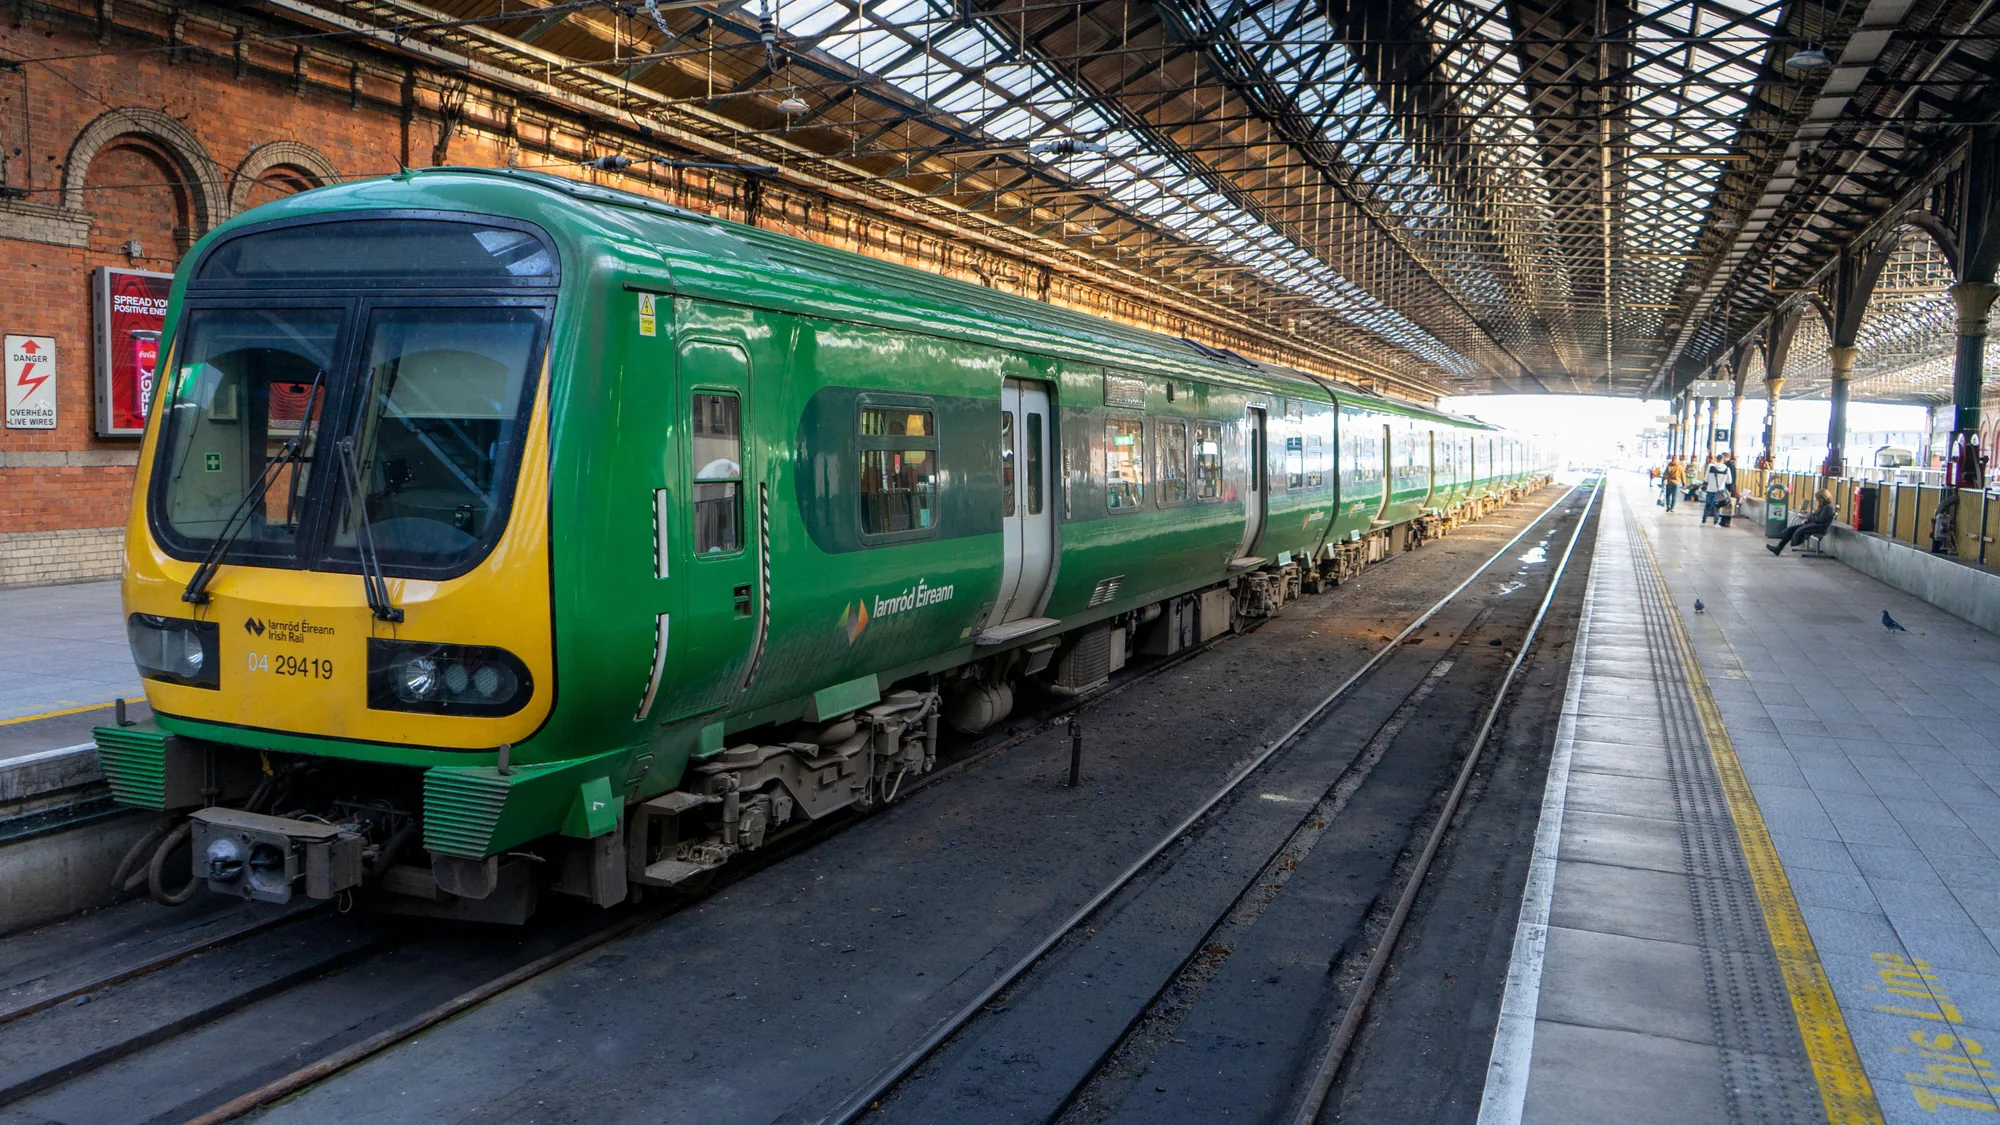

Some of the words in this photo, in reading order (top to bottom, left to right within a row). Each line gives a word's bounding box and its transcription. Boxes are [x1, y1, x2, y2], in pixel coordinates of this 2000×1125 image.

[114, 295, 152, 307] SPREAD
[114, 305, 149, 315] POSITIVE
[13, 354, 48, 363] DANGER
[9, 408, 53, 417] OVERHEAD
[9, 418, 27, 426] LIVE
[29, 418, 54, 426] WIRES
[1718, 431, 1725, 439] 3
[873, 586, 916, 619] Iarnród
[915, 577, 954, 608] Éireann
[268, 619, 300, 632] Iarnród
[301, 619, 335, 635] Éireann
[268, 630, 287, 642] Irish
[288, 632, 304, 643] Rail
[248, 652, 268, 673] 04
[275, 654, 333, 680] 29419
[1864, 952, 1963, 1024] Line
[1892, 1030, 2000, 1112] This
